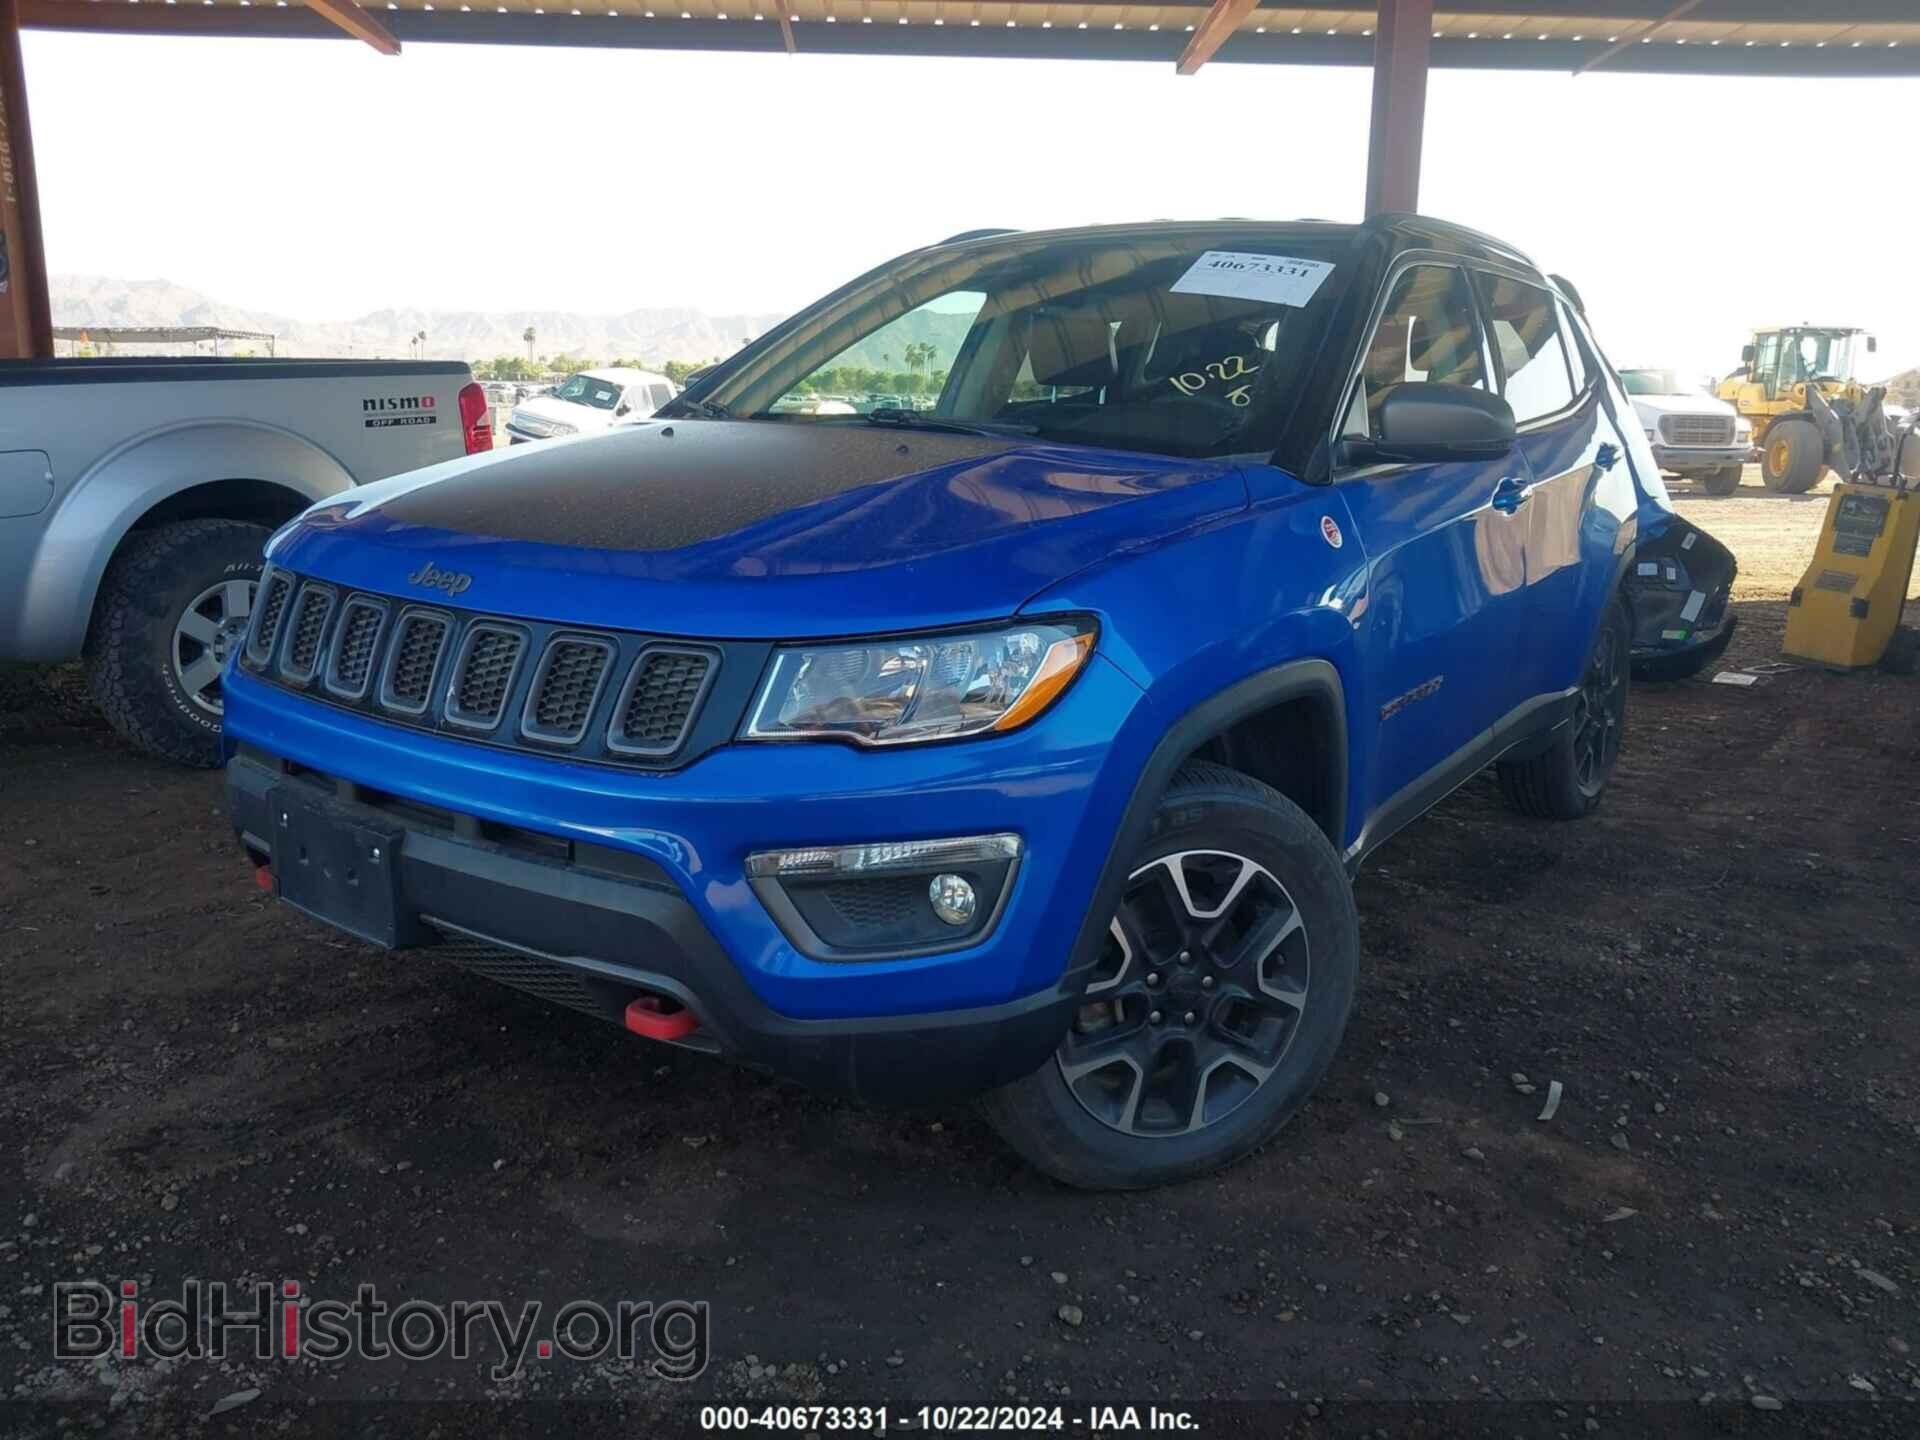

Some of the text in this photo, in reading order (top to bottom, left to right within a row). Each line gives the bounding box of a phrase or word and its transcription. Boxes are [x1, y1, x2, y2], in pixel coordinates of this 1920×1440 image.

[1208, 260, 1309, 278] 40673331
[373, 416, 432, 427] OFF ROAD
[407, 560, 472, 598] Jeep
